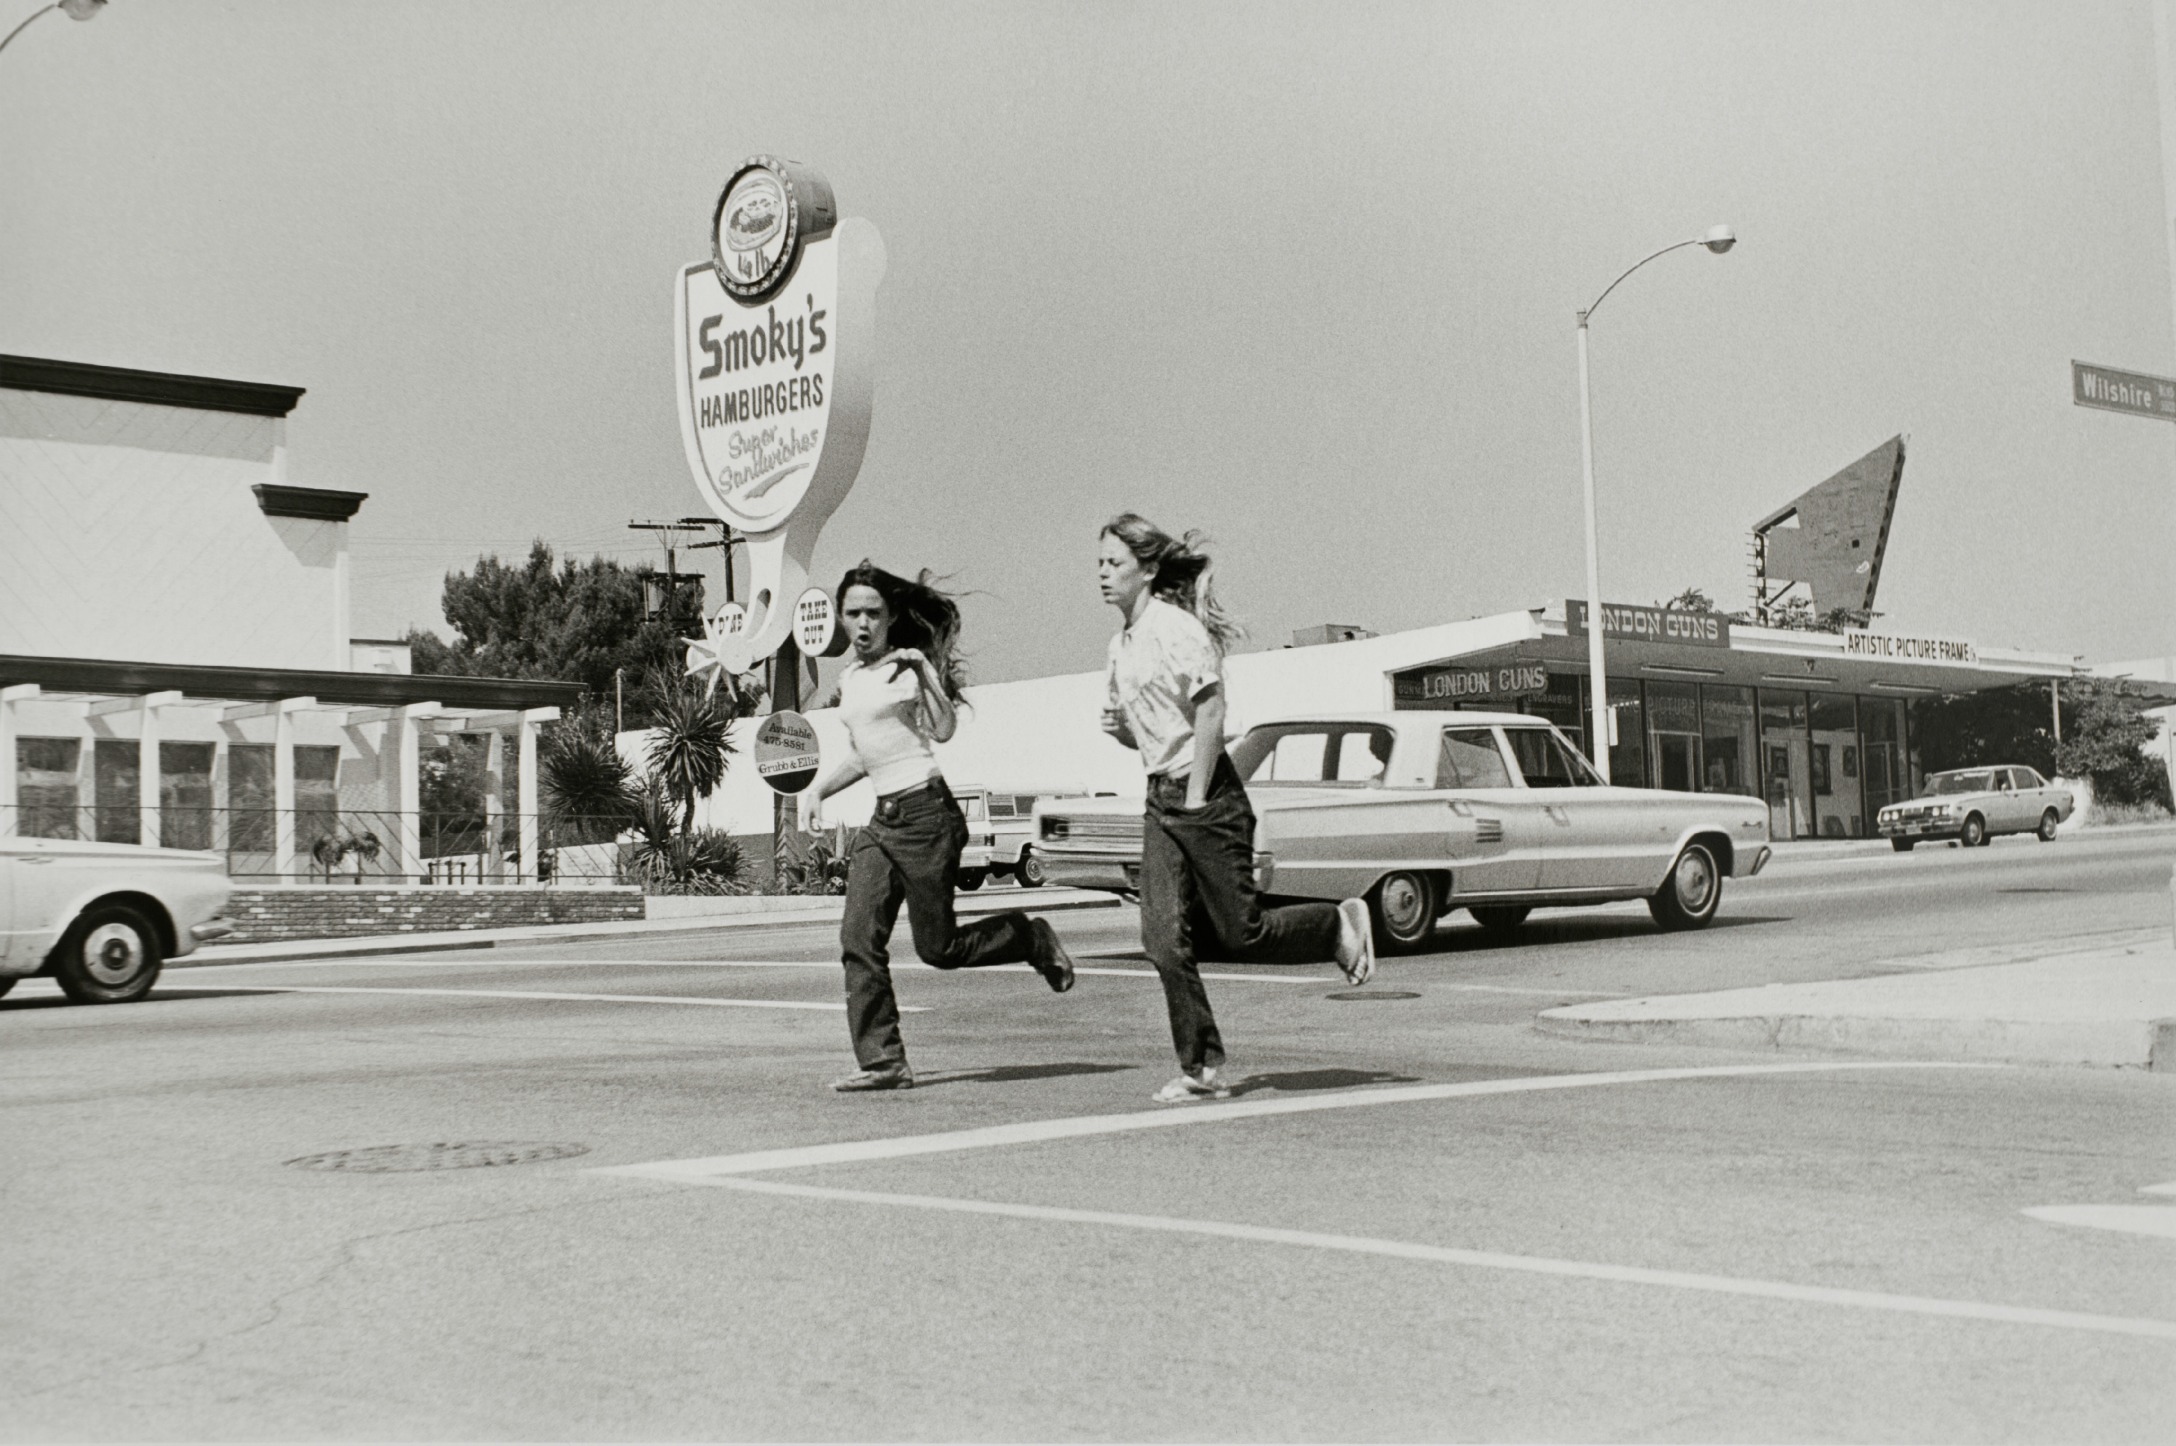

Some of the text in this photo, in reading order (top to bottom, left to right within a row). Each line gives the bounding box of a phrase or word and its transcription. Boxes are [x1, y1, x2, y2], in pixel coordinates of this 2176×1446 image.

[698, 293, 827, 380] Smoky's
[700, 373, 823, 428] HAMBURGERS
[2082, 372, 2152, 408] Wilshire
[728, 425, 777, 460] Super
[719, 427, 818, 495] Sandwiches
[800, 600, 827, 621] TAKE
[804, 625, 824, 645] OUT
[1667, 614, 1719, 640] GUNS
[1848, 633, 1893, 656] ARTISTIC
[1896, 637, 1937, 660] PICTURE
[1939, 640, 1969, 662] FRAME
[1424, 666, 1546, 699] LONDON GUNS
[768, 722, 812, 740] Available
[758, 757, 820, 774] Grubb & Ellis
